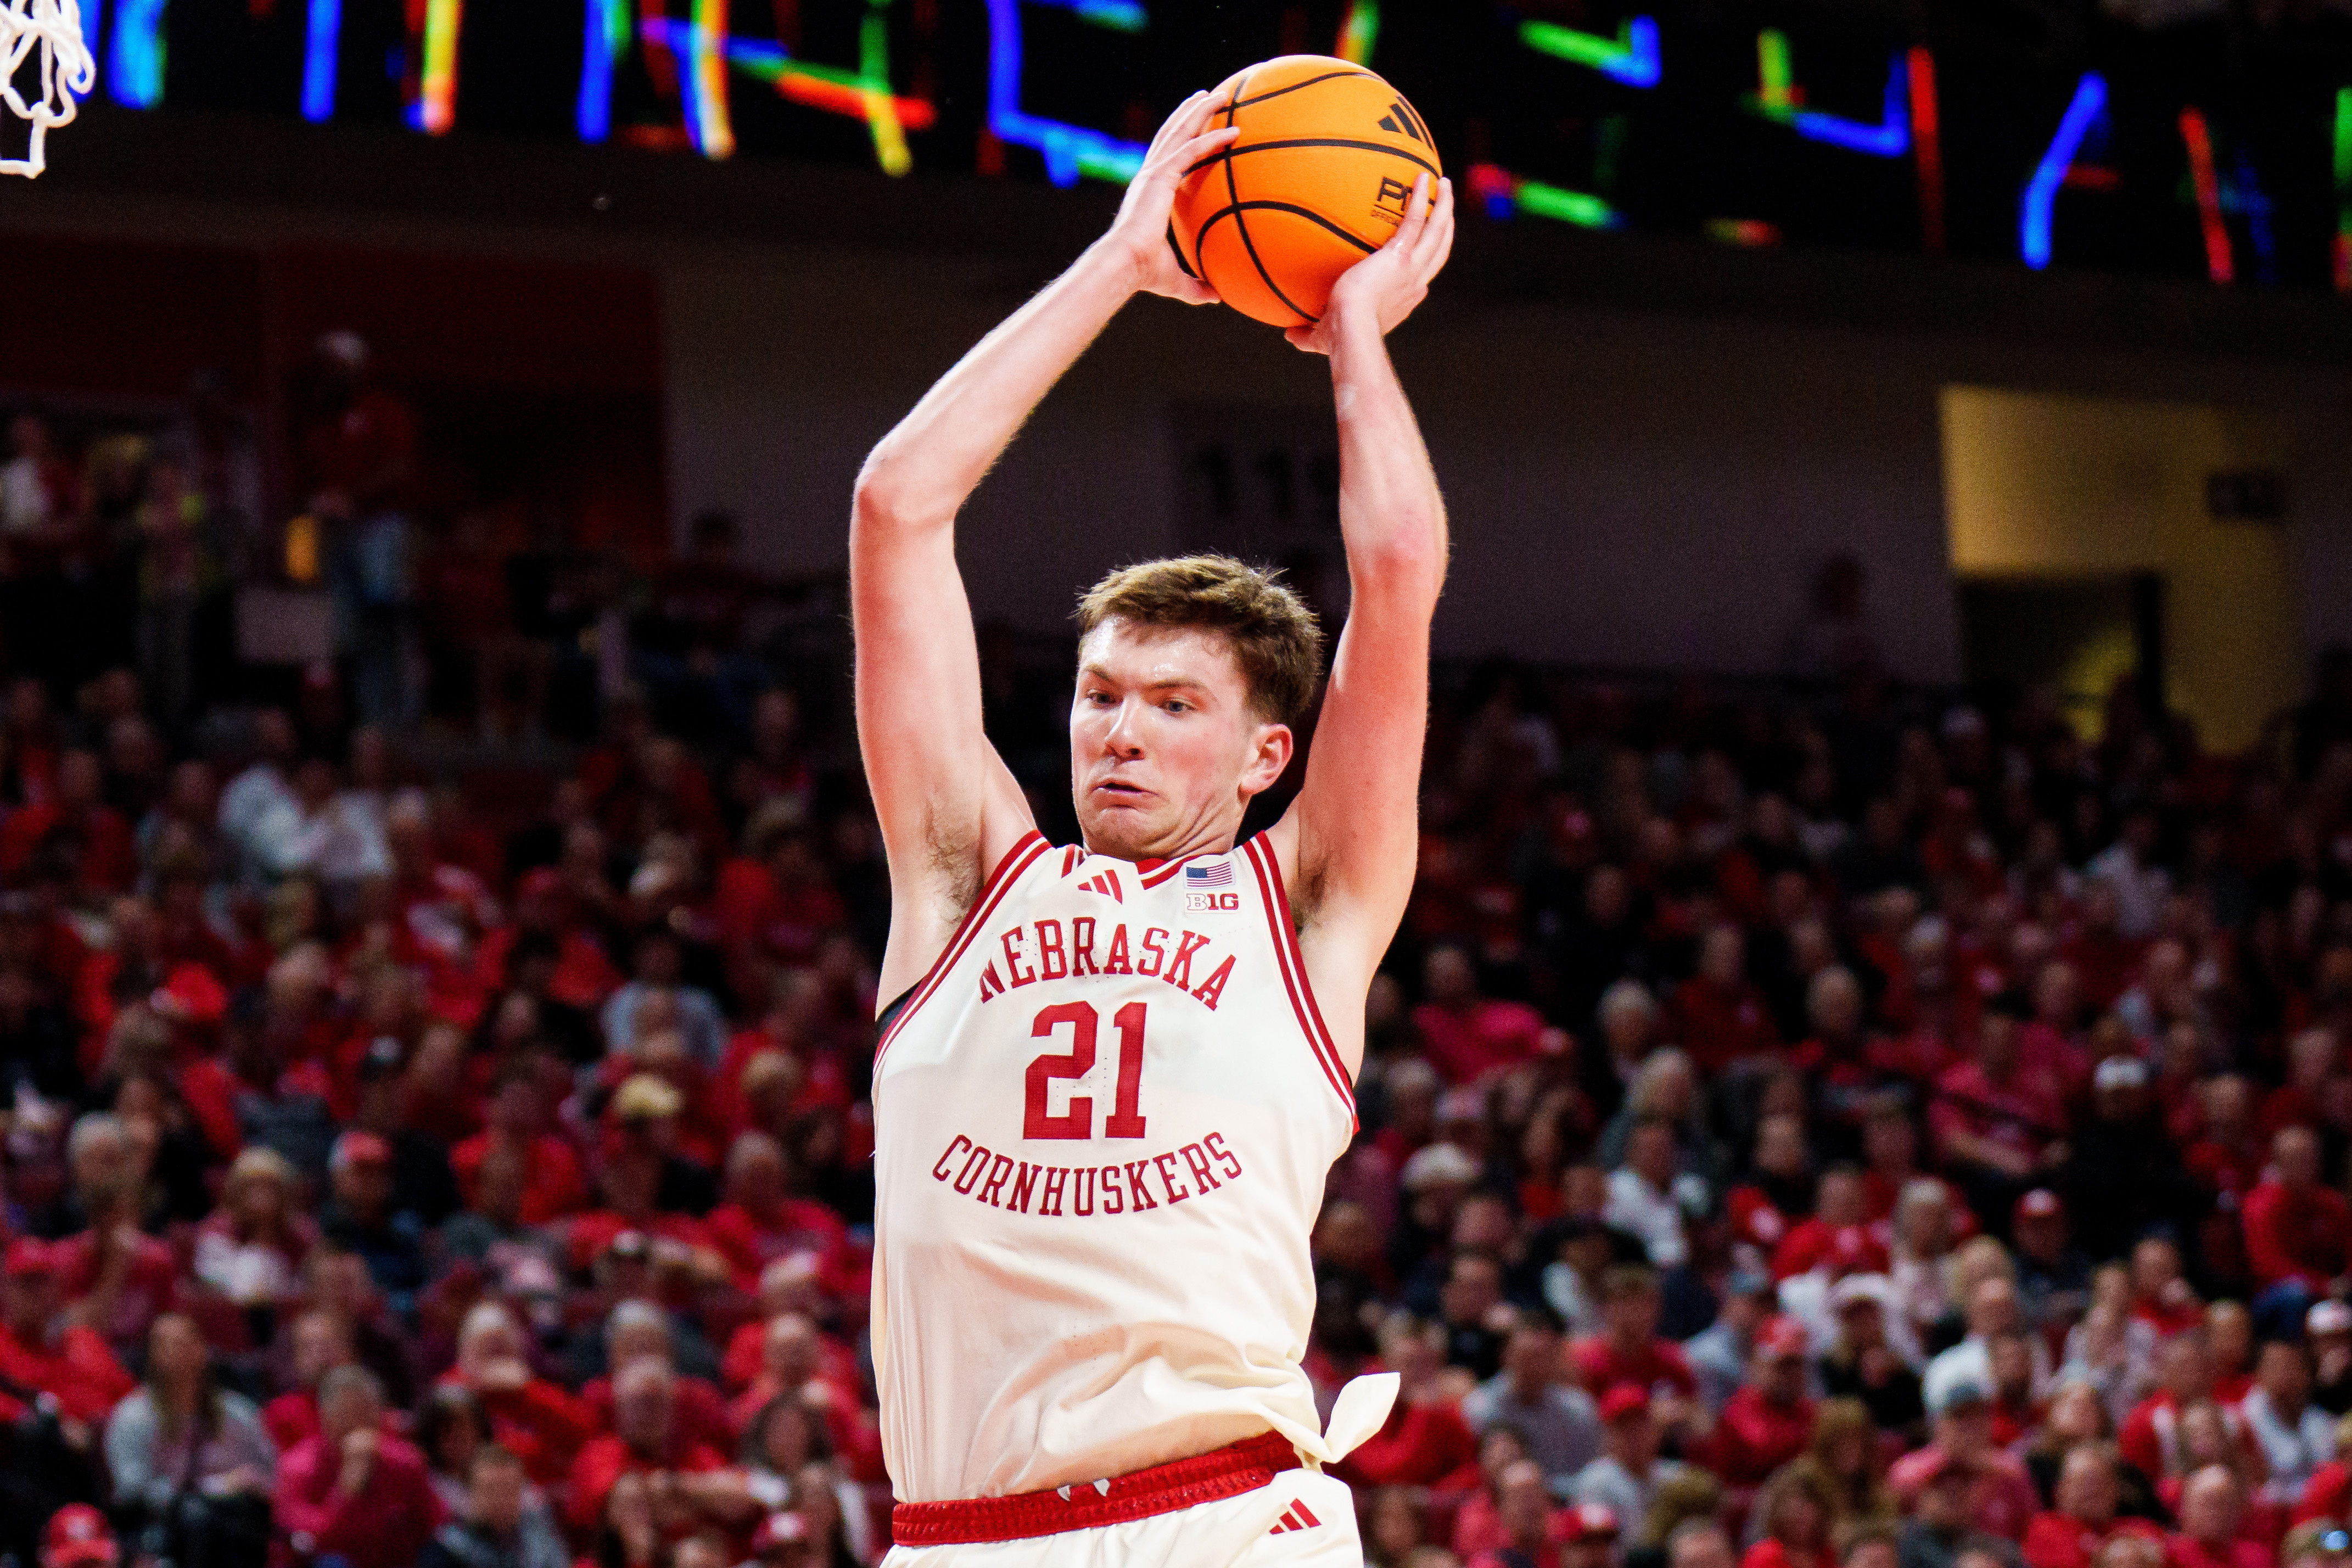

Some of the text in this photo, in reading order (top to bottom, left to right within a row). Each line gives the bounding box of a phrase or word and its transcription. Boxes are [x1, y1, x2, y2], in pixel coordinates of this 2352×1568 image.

[979, 916, 1236, 1011] NEBRASKA
[1022, 1000, 1147, 1140] 21
[932, 1131, 1242, 1216] CORNHUSKERS
